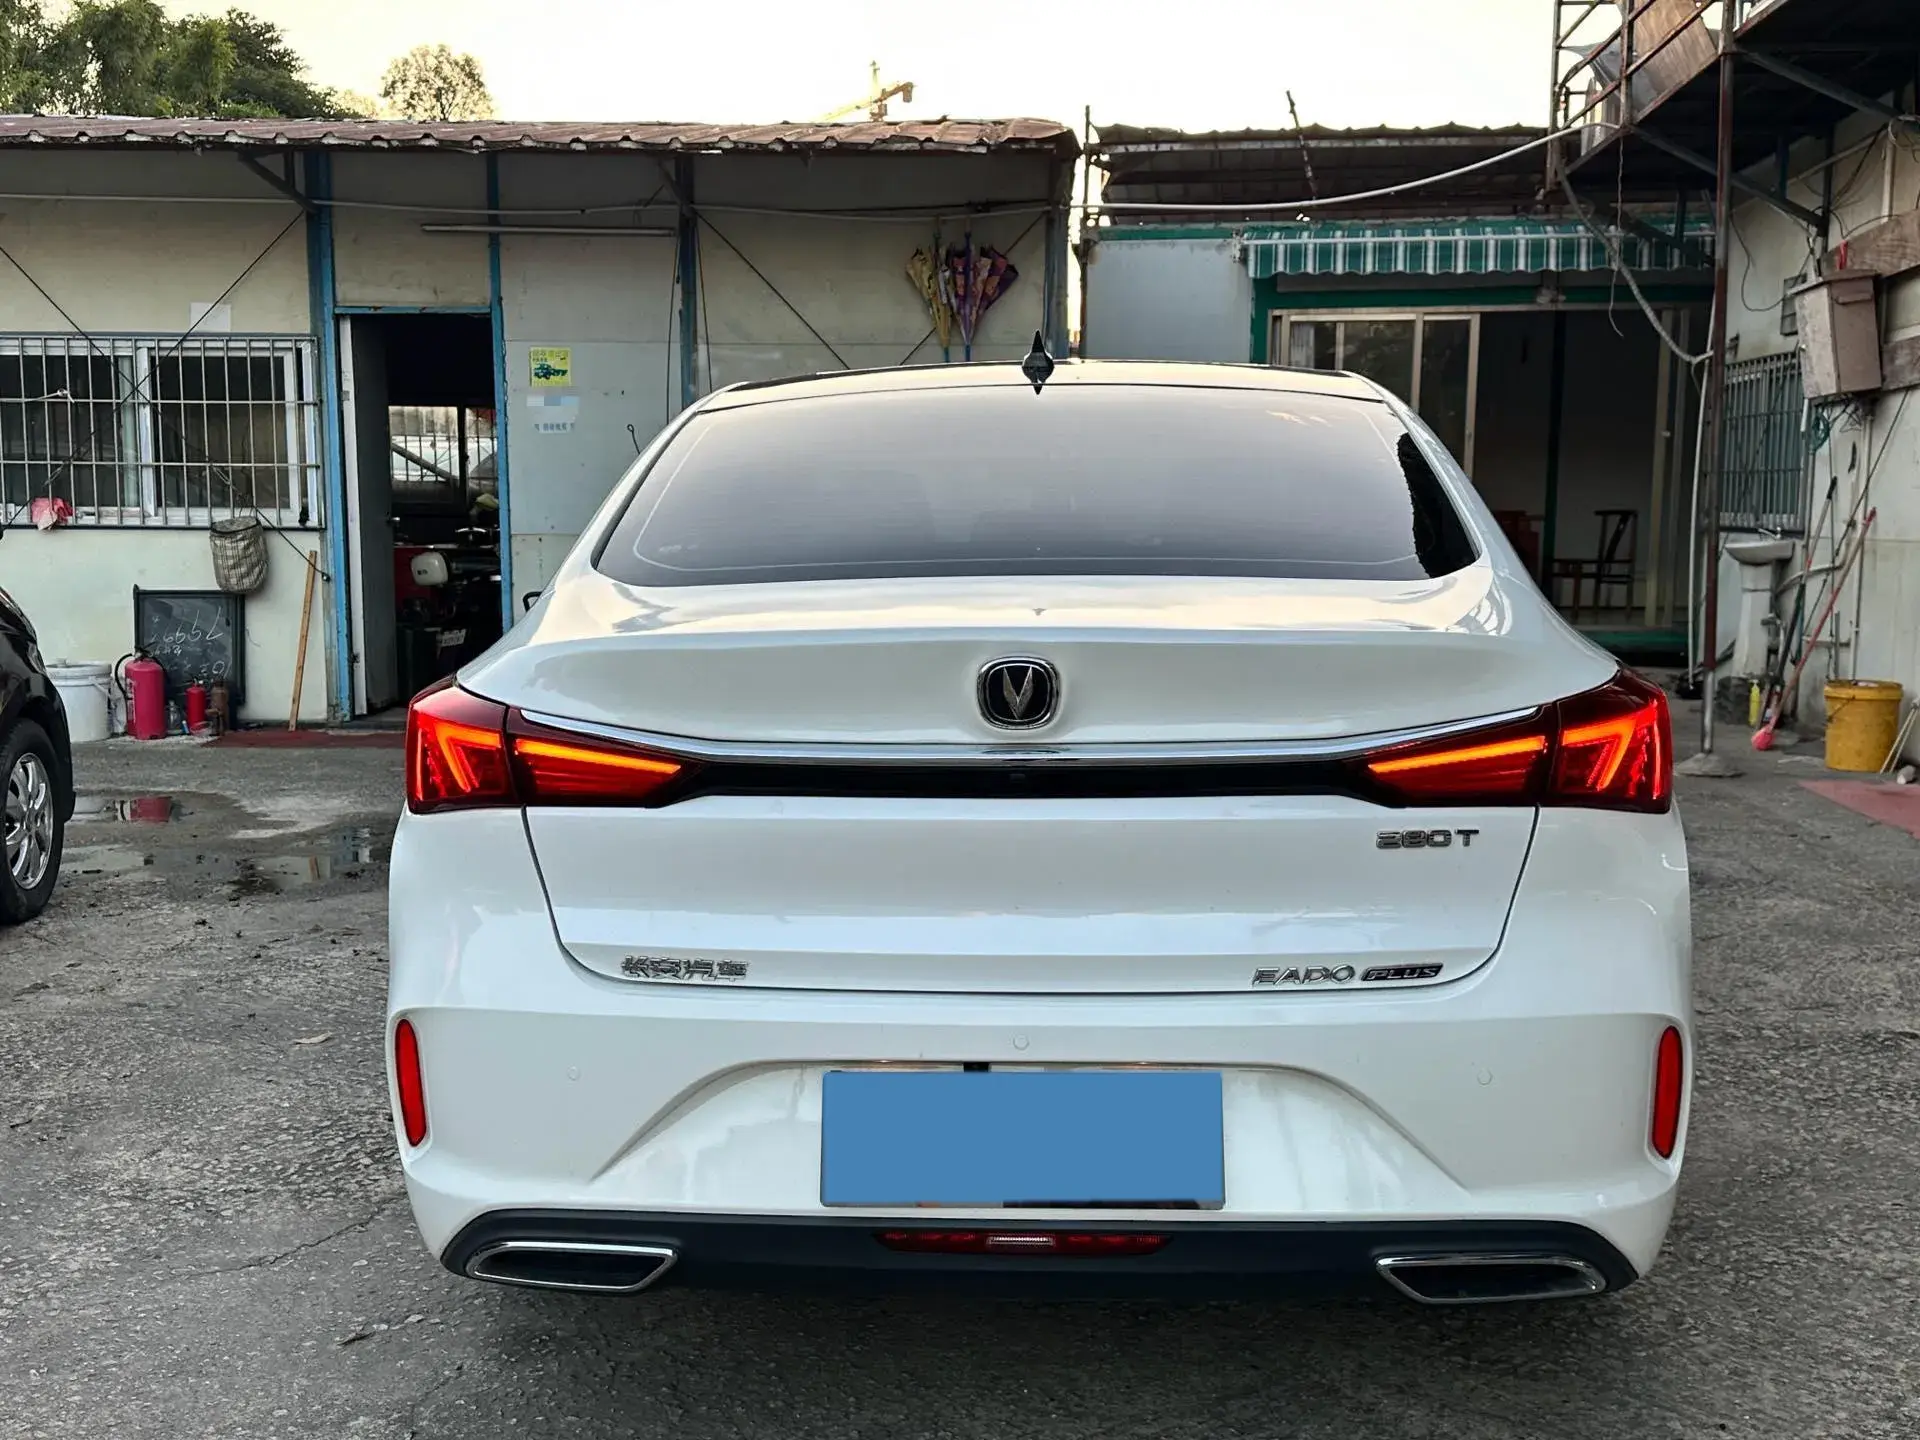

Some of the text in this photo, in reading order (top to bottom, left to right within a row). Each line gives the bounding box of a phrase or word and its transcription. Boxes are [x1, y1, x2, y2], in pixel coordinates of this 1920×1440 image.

[621, 955, 748, 981] 长安汽车
[1252, 964, 1439, 986] EADO PLUS
